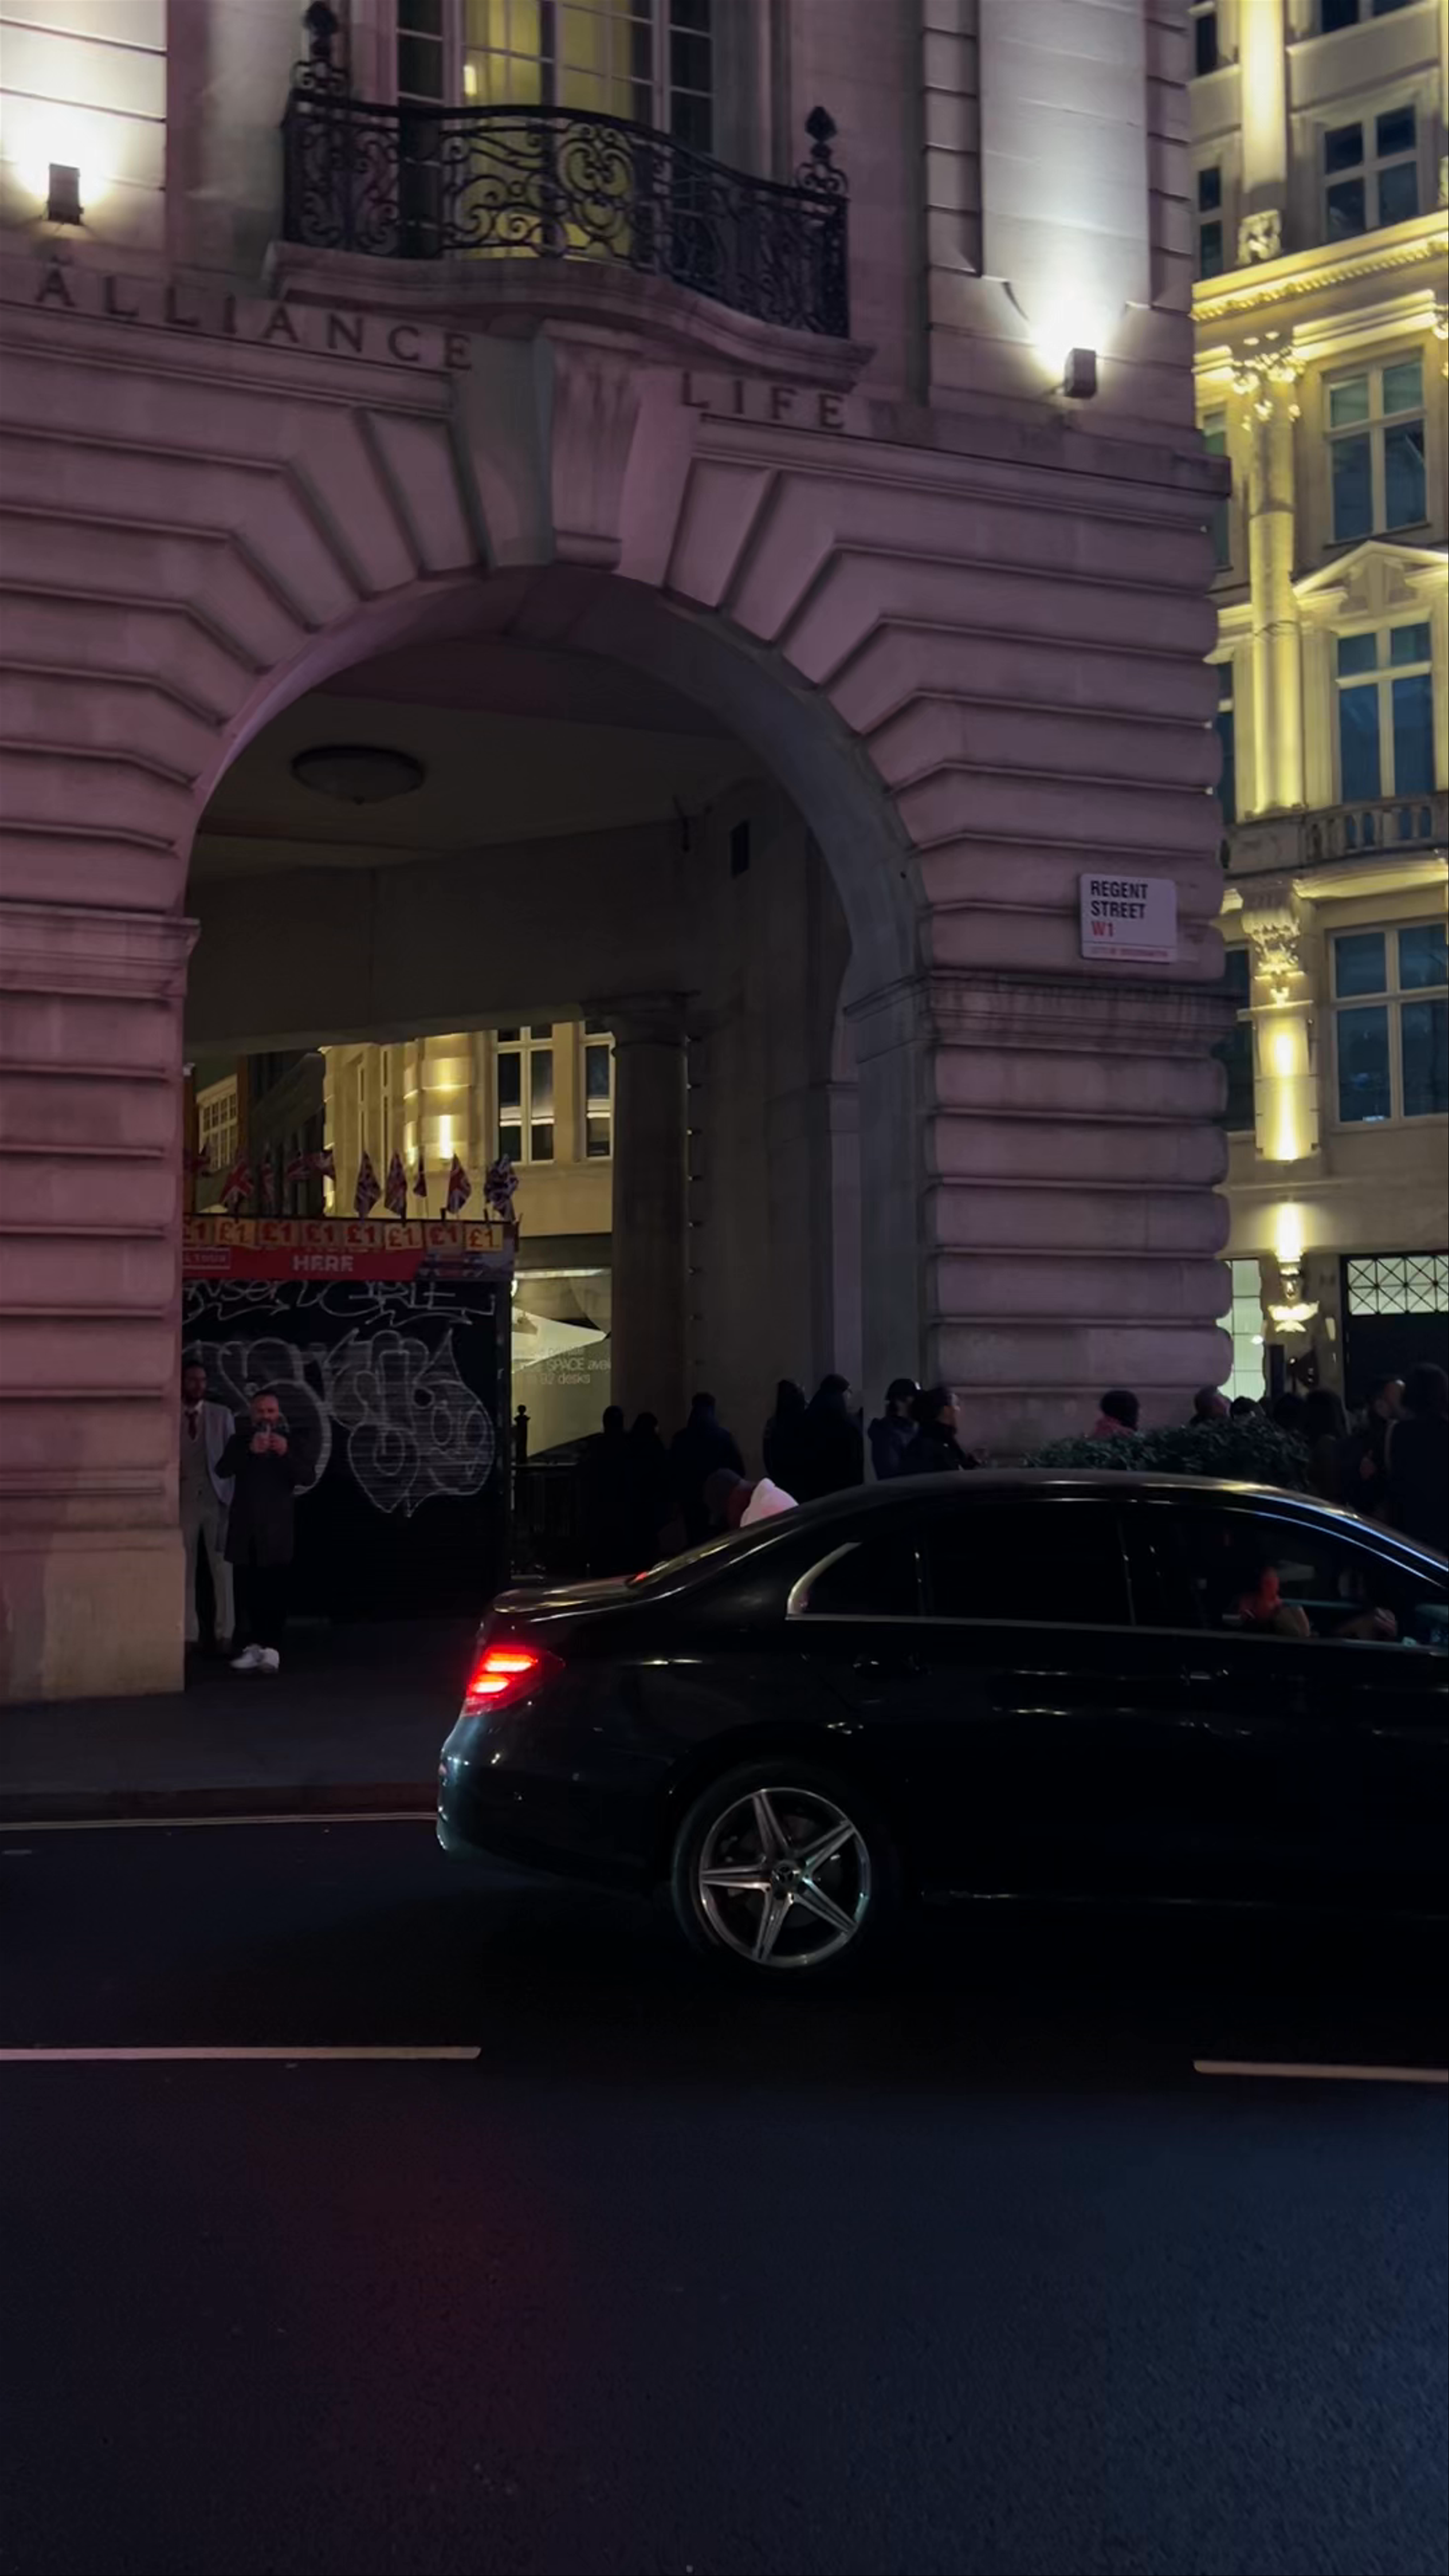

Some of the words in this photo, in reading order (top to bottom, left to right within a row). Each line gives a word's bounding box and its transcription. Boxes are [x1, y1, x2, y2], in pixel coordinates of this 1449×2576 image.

[35, 258, 472, 371] ALLIANCE
[681, 371, 844, 429] LIFE
[1091, 880, 1148, 900] REGENT
[1091, 900, 1146, 919] STREET
[1091, 921, 1113, 937] W1
[346, 1224, 375, 1243] £1
[292, 1255, 354, 1272] HERE
